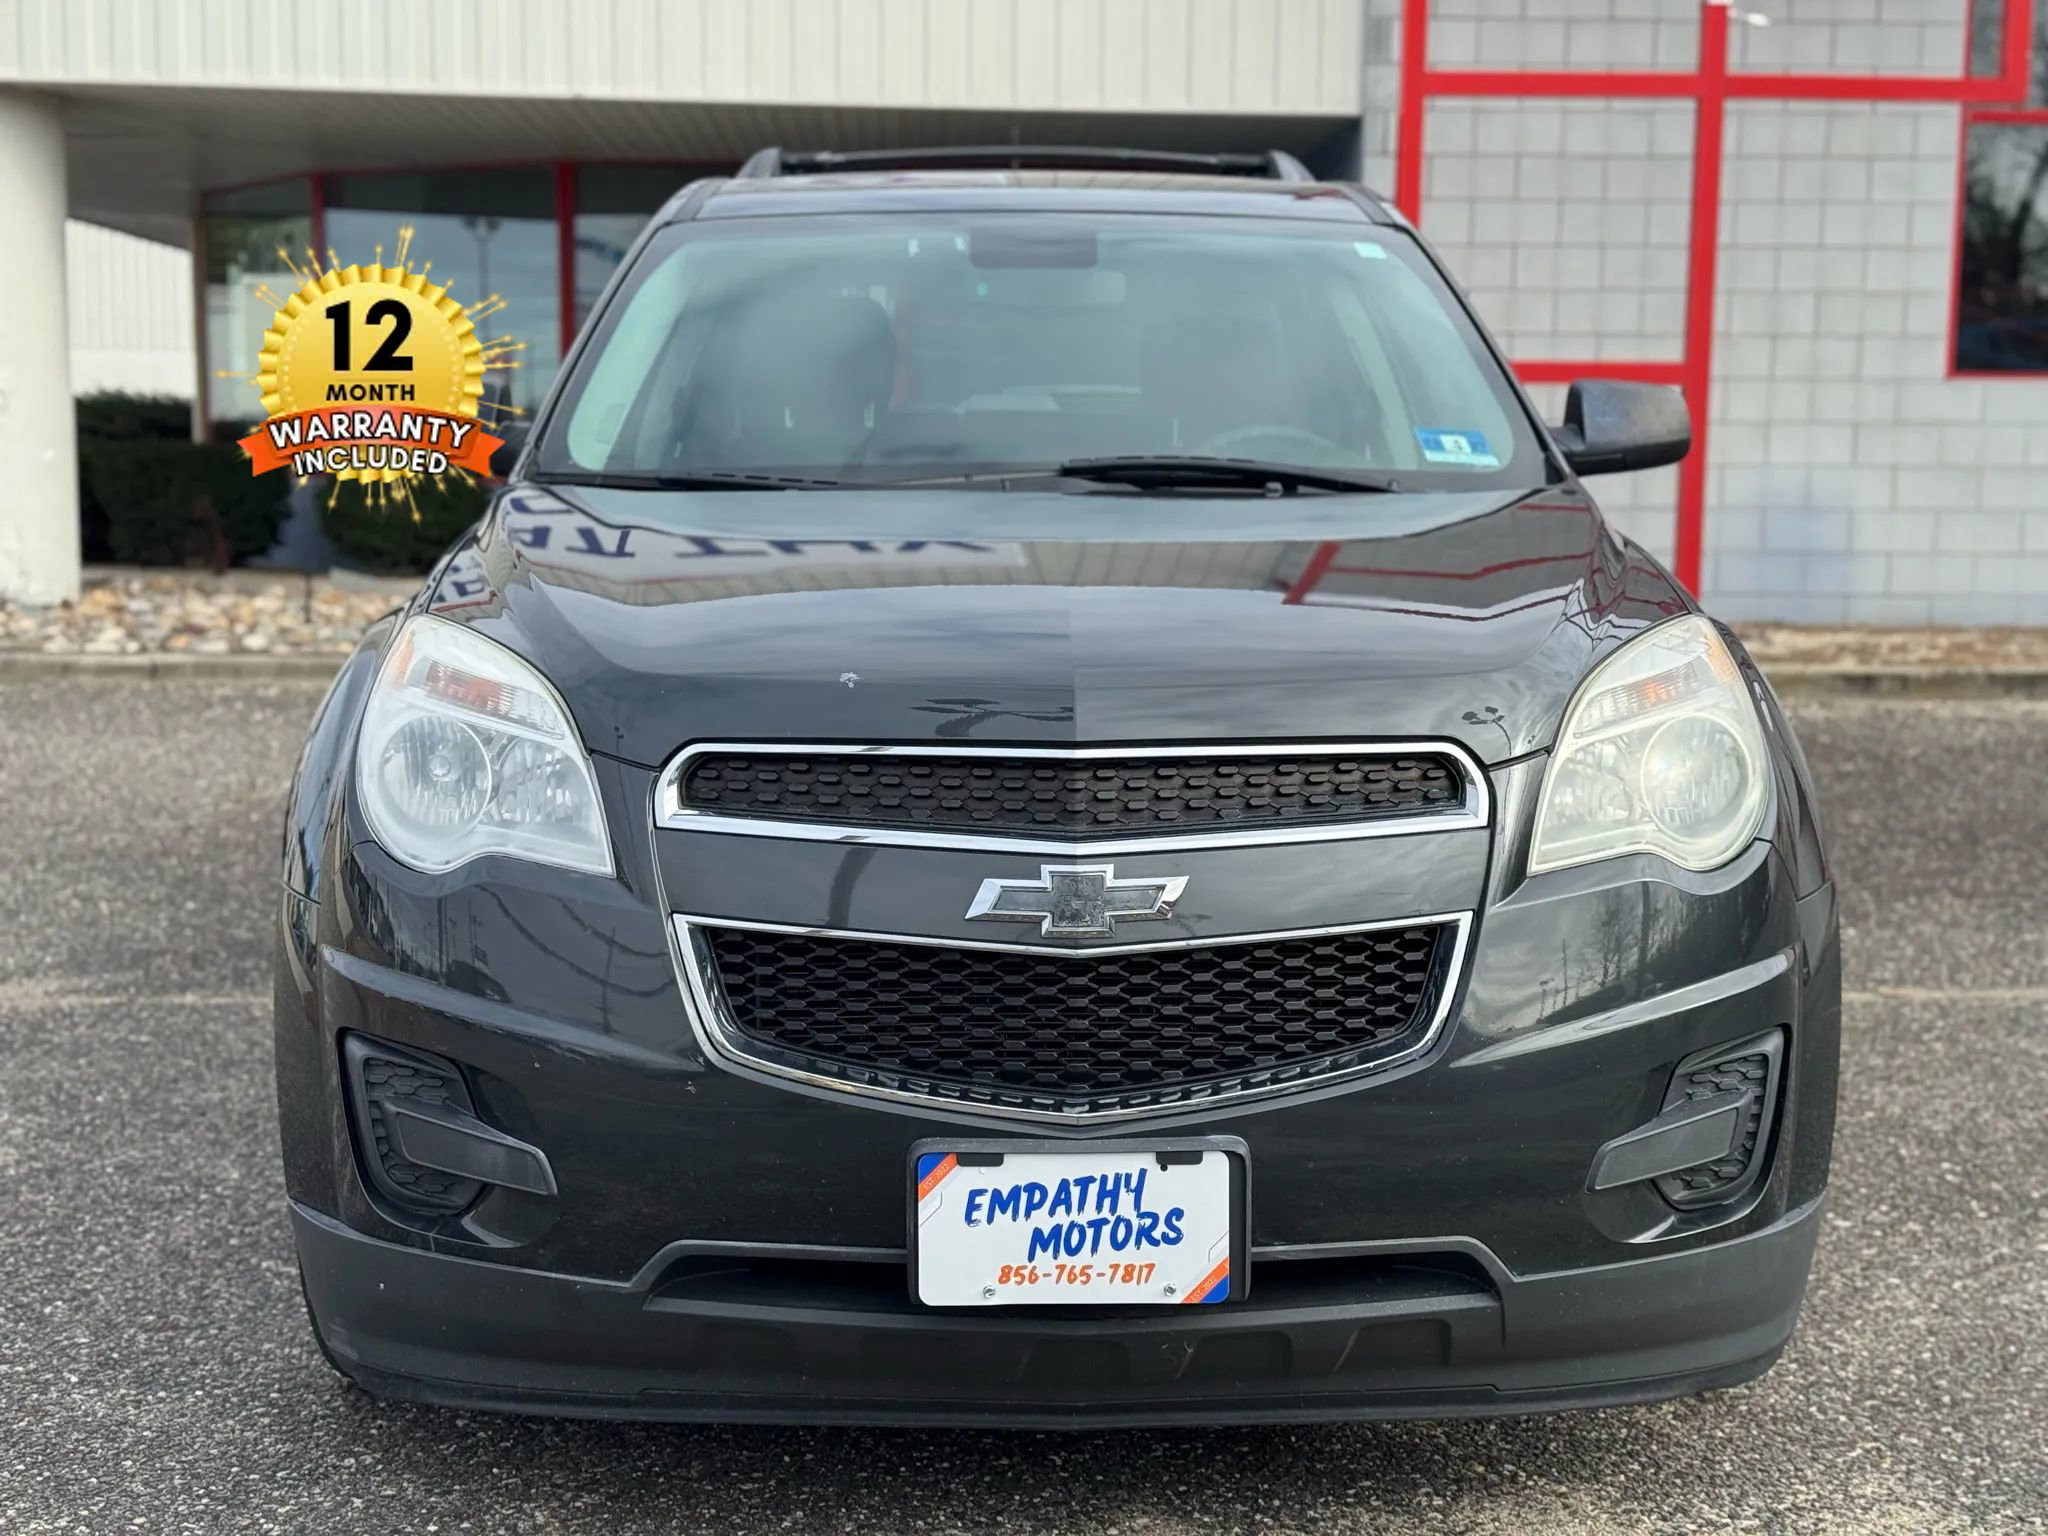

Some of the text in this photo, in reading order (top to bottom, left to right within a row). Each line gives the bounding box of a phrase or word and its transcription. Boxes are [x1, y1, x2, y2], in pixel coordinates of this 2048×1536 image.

[964, 1167, 1149, 1227] EMPATHY
[1027, 1207, 1185, 1263] MOTORS
[998, 1263, 1157, 1286] 856-765-7817
